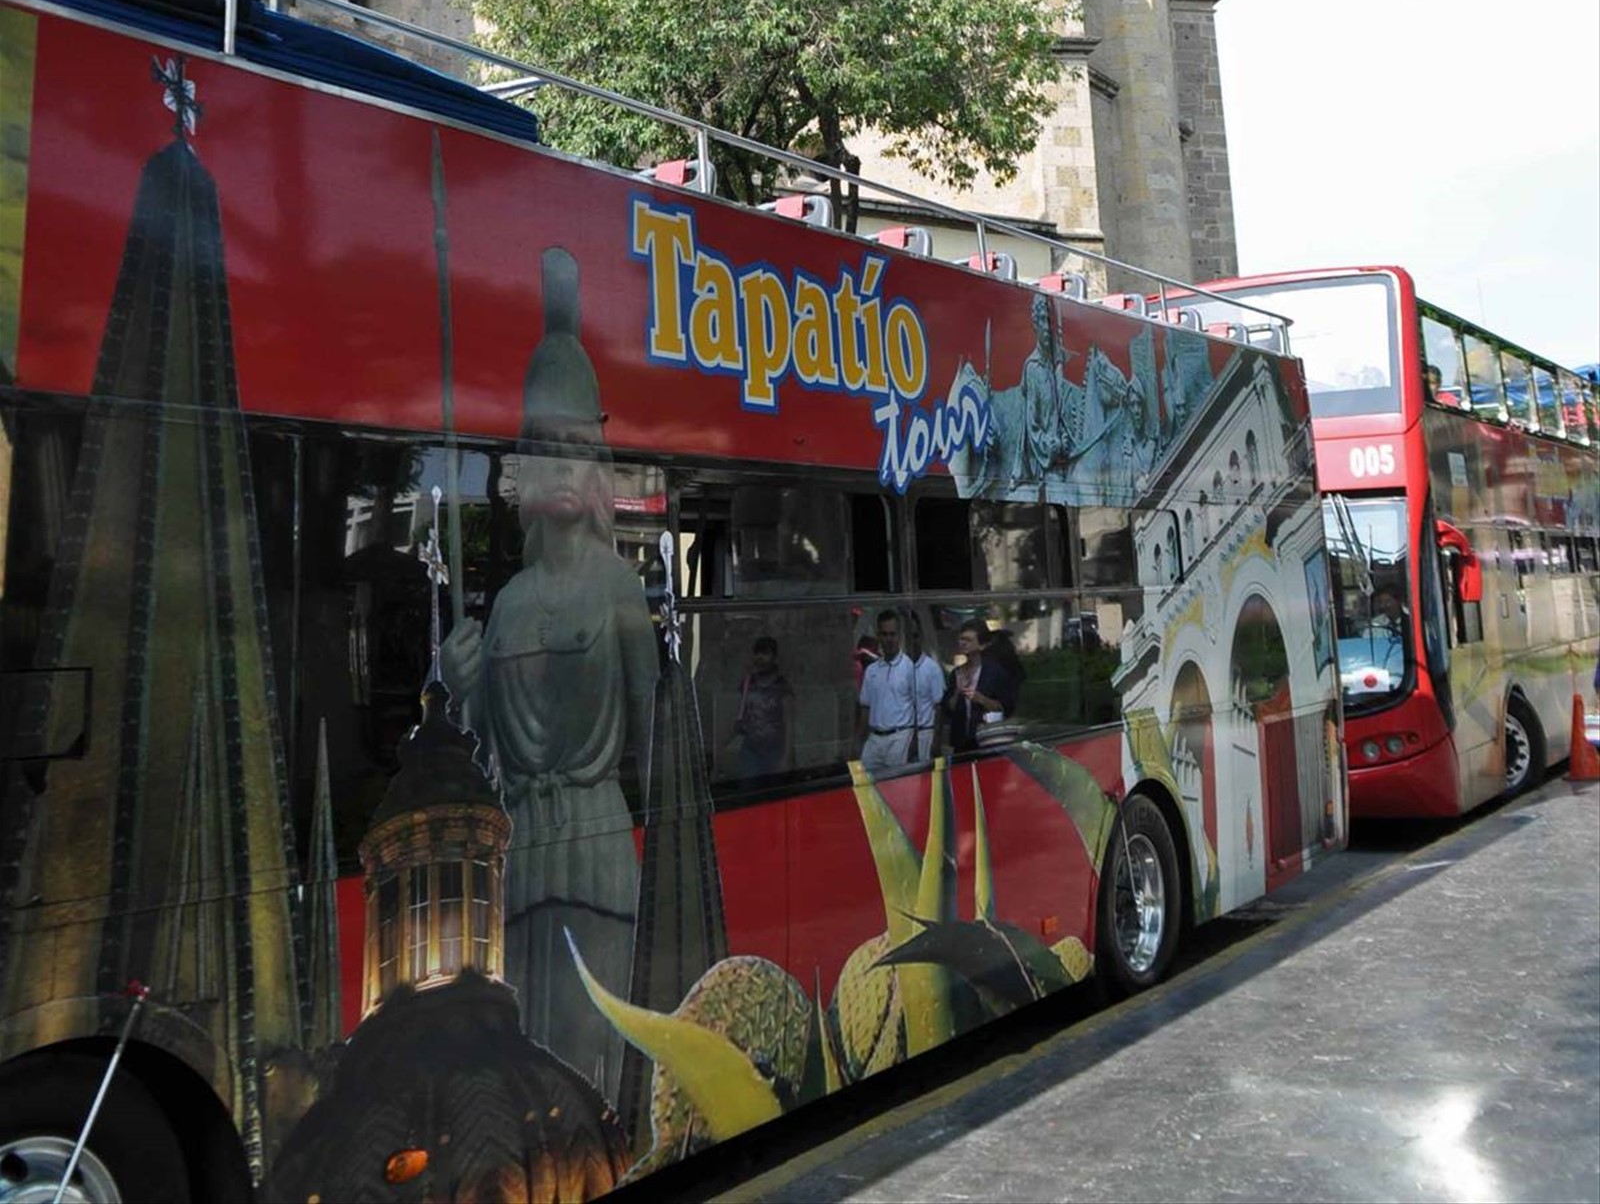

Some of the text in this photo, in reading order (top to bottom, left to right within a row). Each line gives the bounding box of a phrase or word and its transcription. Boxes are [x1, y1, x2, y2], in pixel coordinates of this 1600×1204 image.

[632, 198, 928, 408] Tapatío
[873, 388, 990, 489] tour
[1349, 443, 1396, 479] 005
